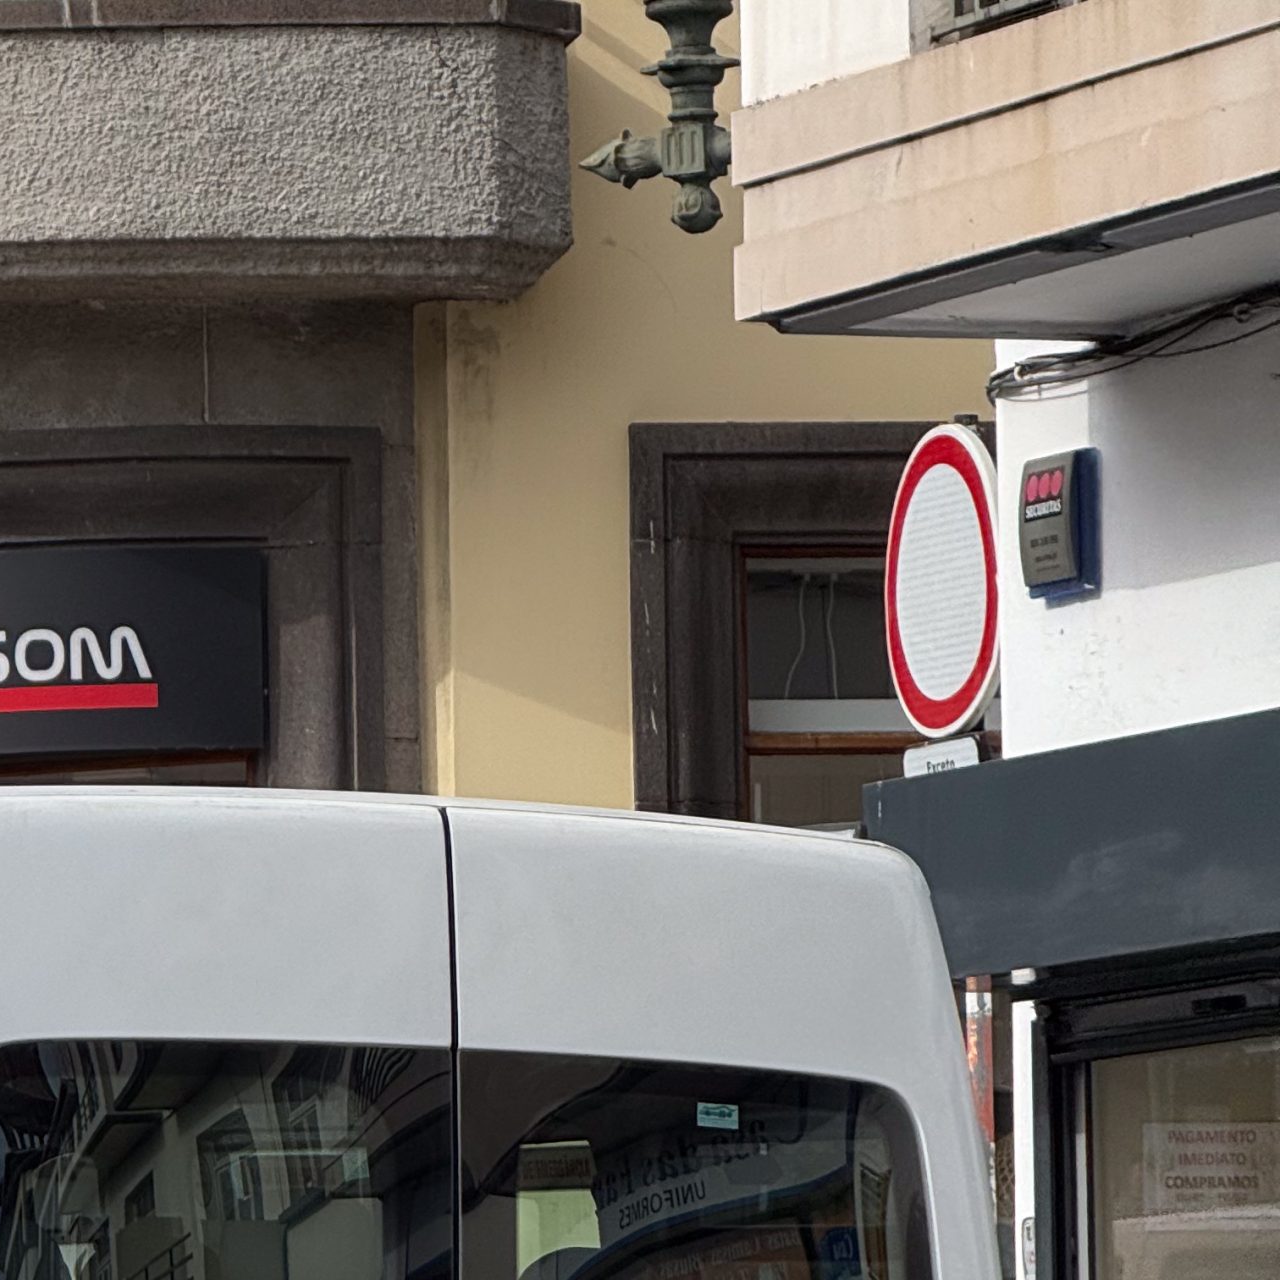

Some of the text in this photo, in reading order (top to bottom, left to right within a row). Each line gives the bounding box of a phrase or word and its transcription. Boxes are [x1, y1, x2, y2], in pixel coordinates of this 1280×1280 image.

[1168, 1130, 1257, 1143] PAGAMENTO
[1178, 1152, 1246, 1166] IMEDIATO
[1165, 1175, 1259, 1189] COMPRAMOS
